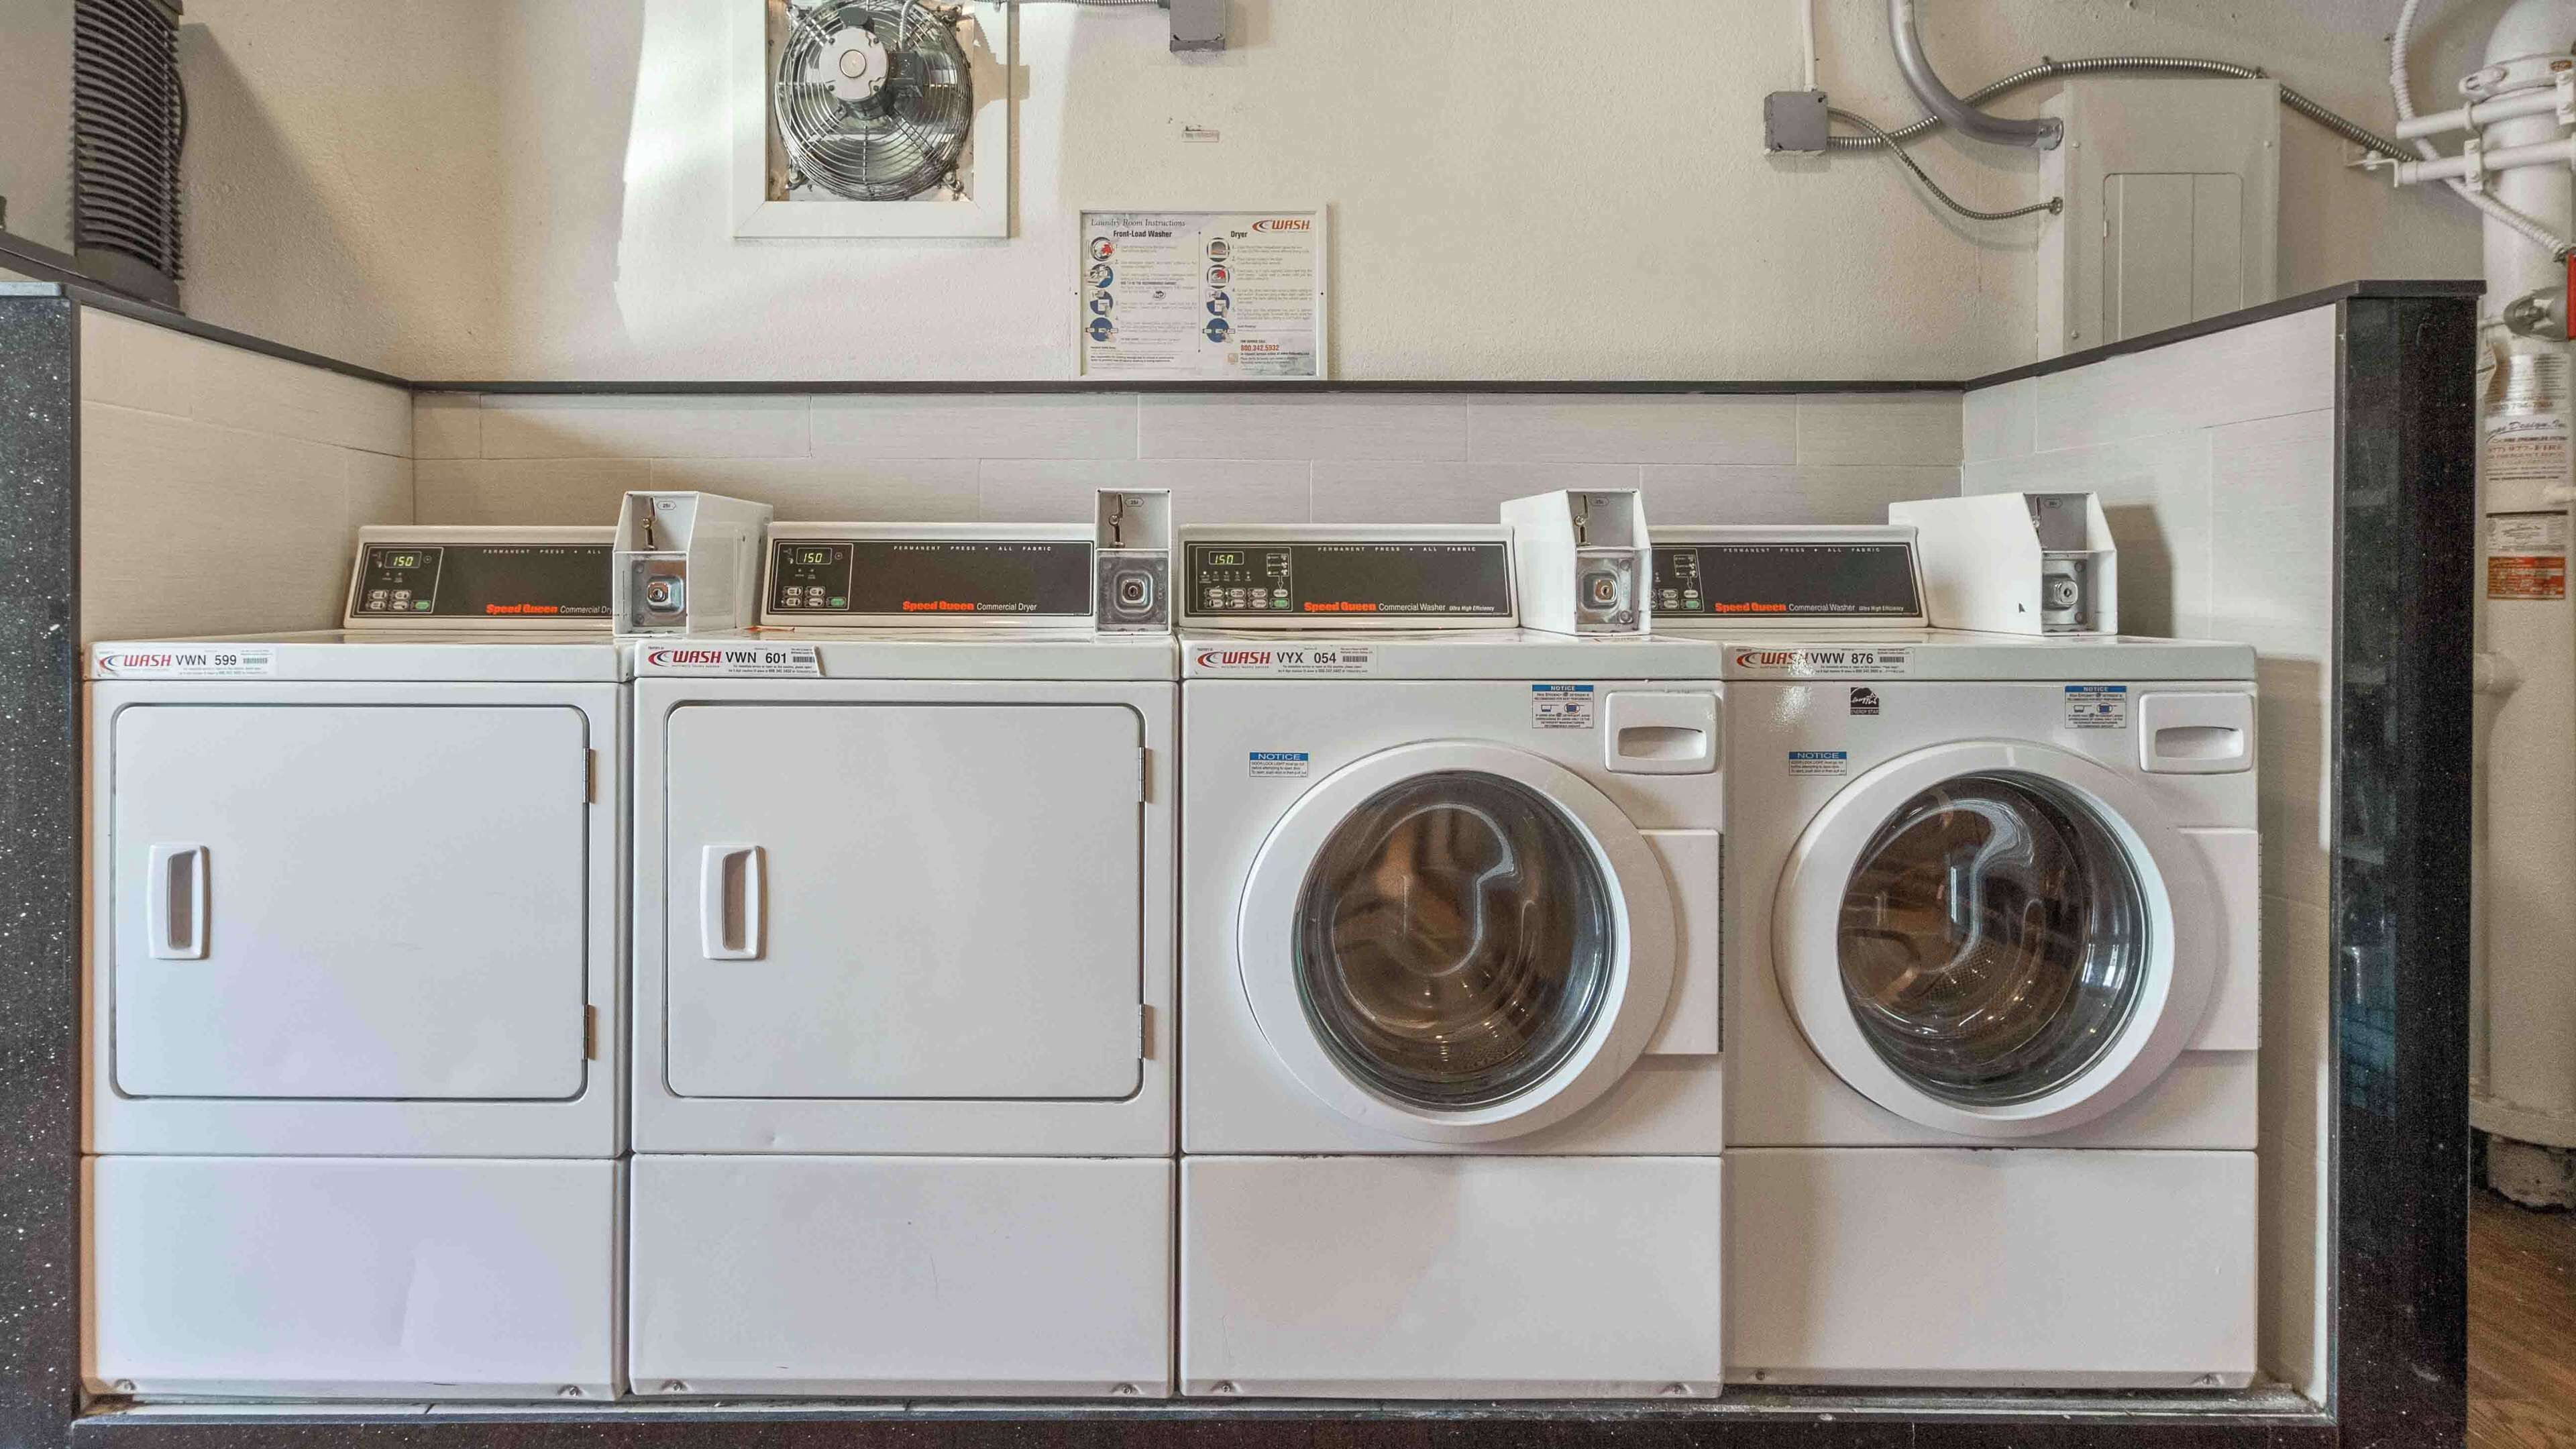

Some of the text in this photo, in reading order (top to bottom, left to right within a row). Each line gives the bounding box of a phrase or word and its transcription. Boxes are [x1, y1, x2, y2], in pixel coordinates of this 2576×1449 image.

[1091, 219, 1120, 227] Laundry
[1271, 219, 1311, 230] WASH
[1230, 231, 1248, 239] Dryer
[393, 556, 413, 566] 150
[804, 553, 822, 563] 150
[1215, 555, 1234, 564] 150
[486, 604, 612, 614] Speed Queen Commercial Dry
[902, 600, 937, 612] Speed
[939, 600, 974, 611] Queen
[1018, 603, 1037, 612] Dryer
[1304, 602, 1340, 612] Speed
[1341, 602, 1377, 611] Queen
[1379, 603, 1419, 611] Commercial
[1419, 603, 1446, 611] Washer
[1715, 603, 1750, 612] Speed
[1751, 603, 1786, 612] Queen
[123, 655, 237, 666] WASH VWN 599
[672, 651, 786, 663] WASH VWN 601
[1222, 651, 1336, 664] WASH VYX 054
[1760, 652, 1874, 664] WAS VWW 876
